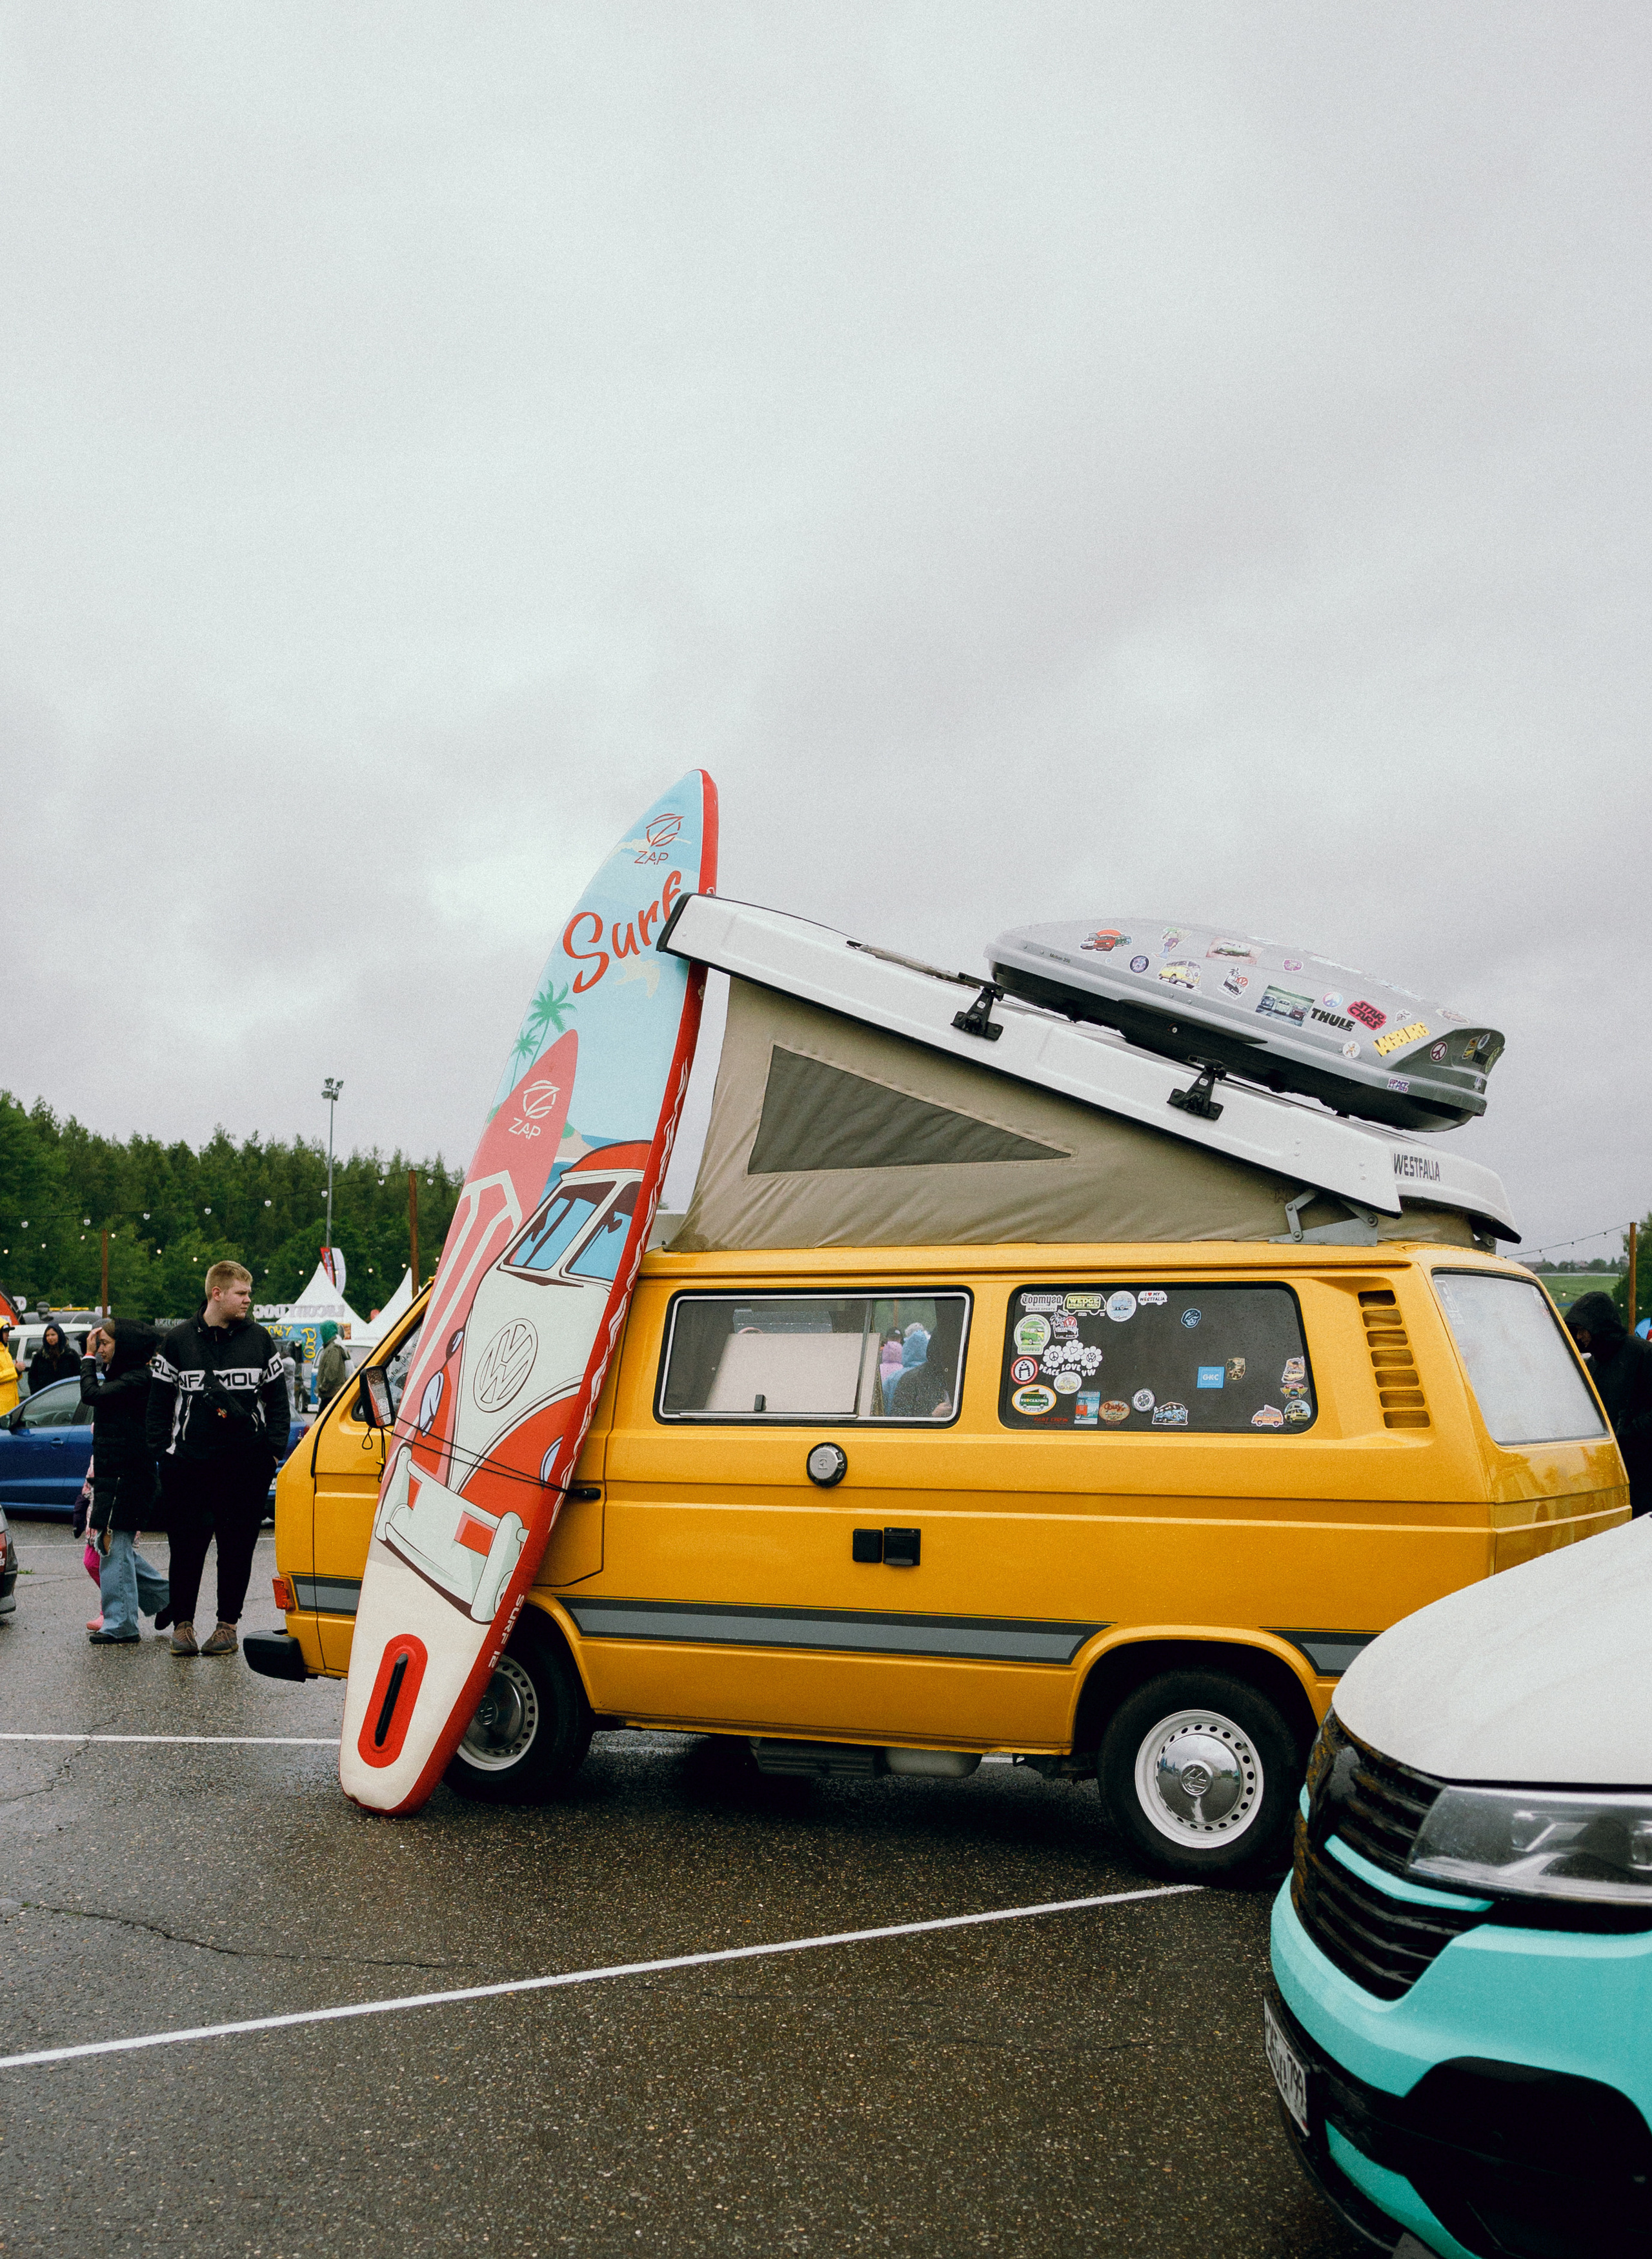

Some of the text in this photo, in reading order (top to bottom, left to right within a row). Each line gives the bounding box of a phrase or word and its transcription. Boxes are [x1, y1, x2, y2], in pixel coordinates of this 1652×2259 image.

[634, 850, 669, 866] ZAP
[562, 870, 682, 993] Surf
[1311, 1008, 1356, 1032] THULE
[1349, 1006, 1384, 1031] CARS
[1355, 1001, 1385, 1022] STAR
[508, 1117, 541, 1140] ZAP
[1394, 1153, 1440, 1182] WESTFALIA
[301, 1327, 317, 1359] DOG
[1038, 1364, 1060, 1376] PEACE
[1061, 1363, 1082, 1372] LOVE
[1081, 1369, 1096, 1377] VW
[501, 1594, 525, 1645] SURF
[488, 1650, 501, 1668] 12
